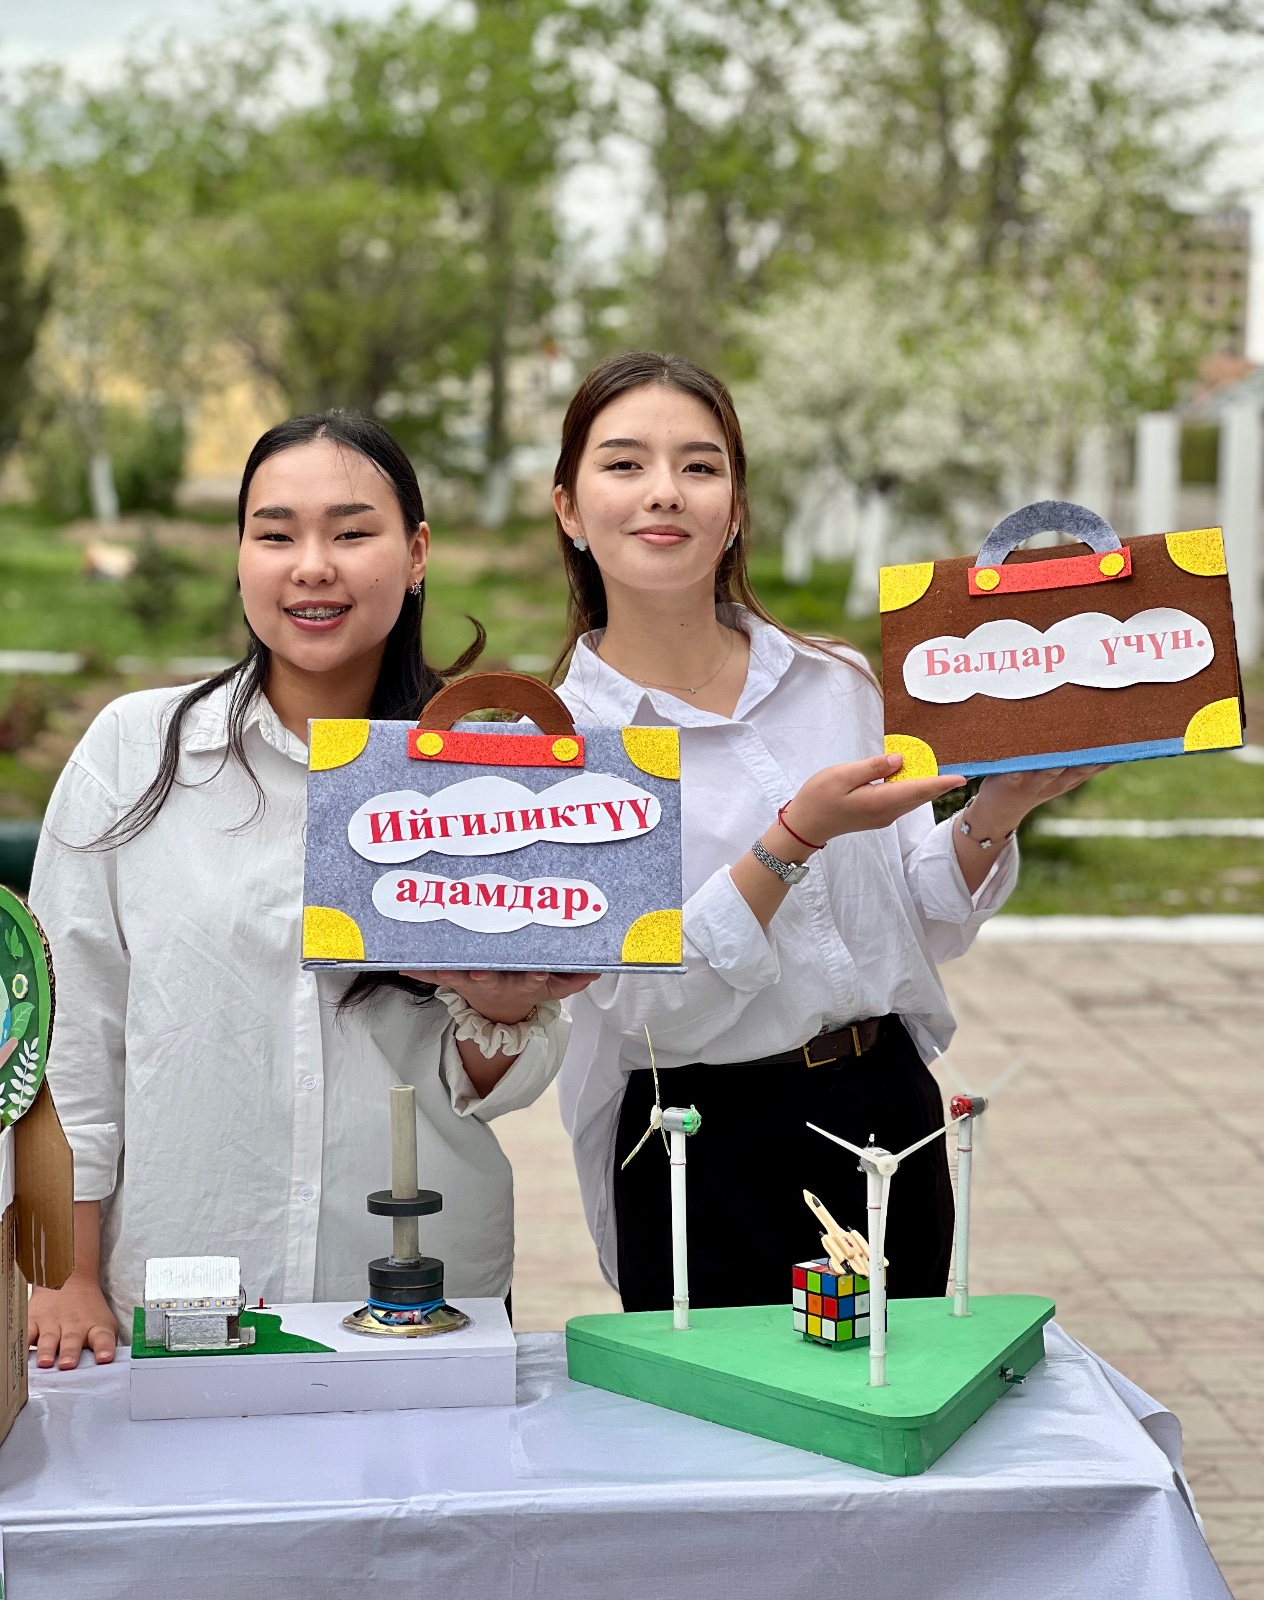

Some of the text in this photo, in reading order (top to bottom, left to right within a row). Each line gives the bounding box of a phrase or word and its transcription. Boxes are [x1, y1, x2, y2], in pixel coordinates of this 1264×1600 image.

[923, 628, 1206, 677] Балдар үчүн.
[364, 797, 652, 845] Ийгиликтүү
[395, 877, 602, 921] адамдар.
